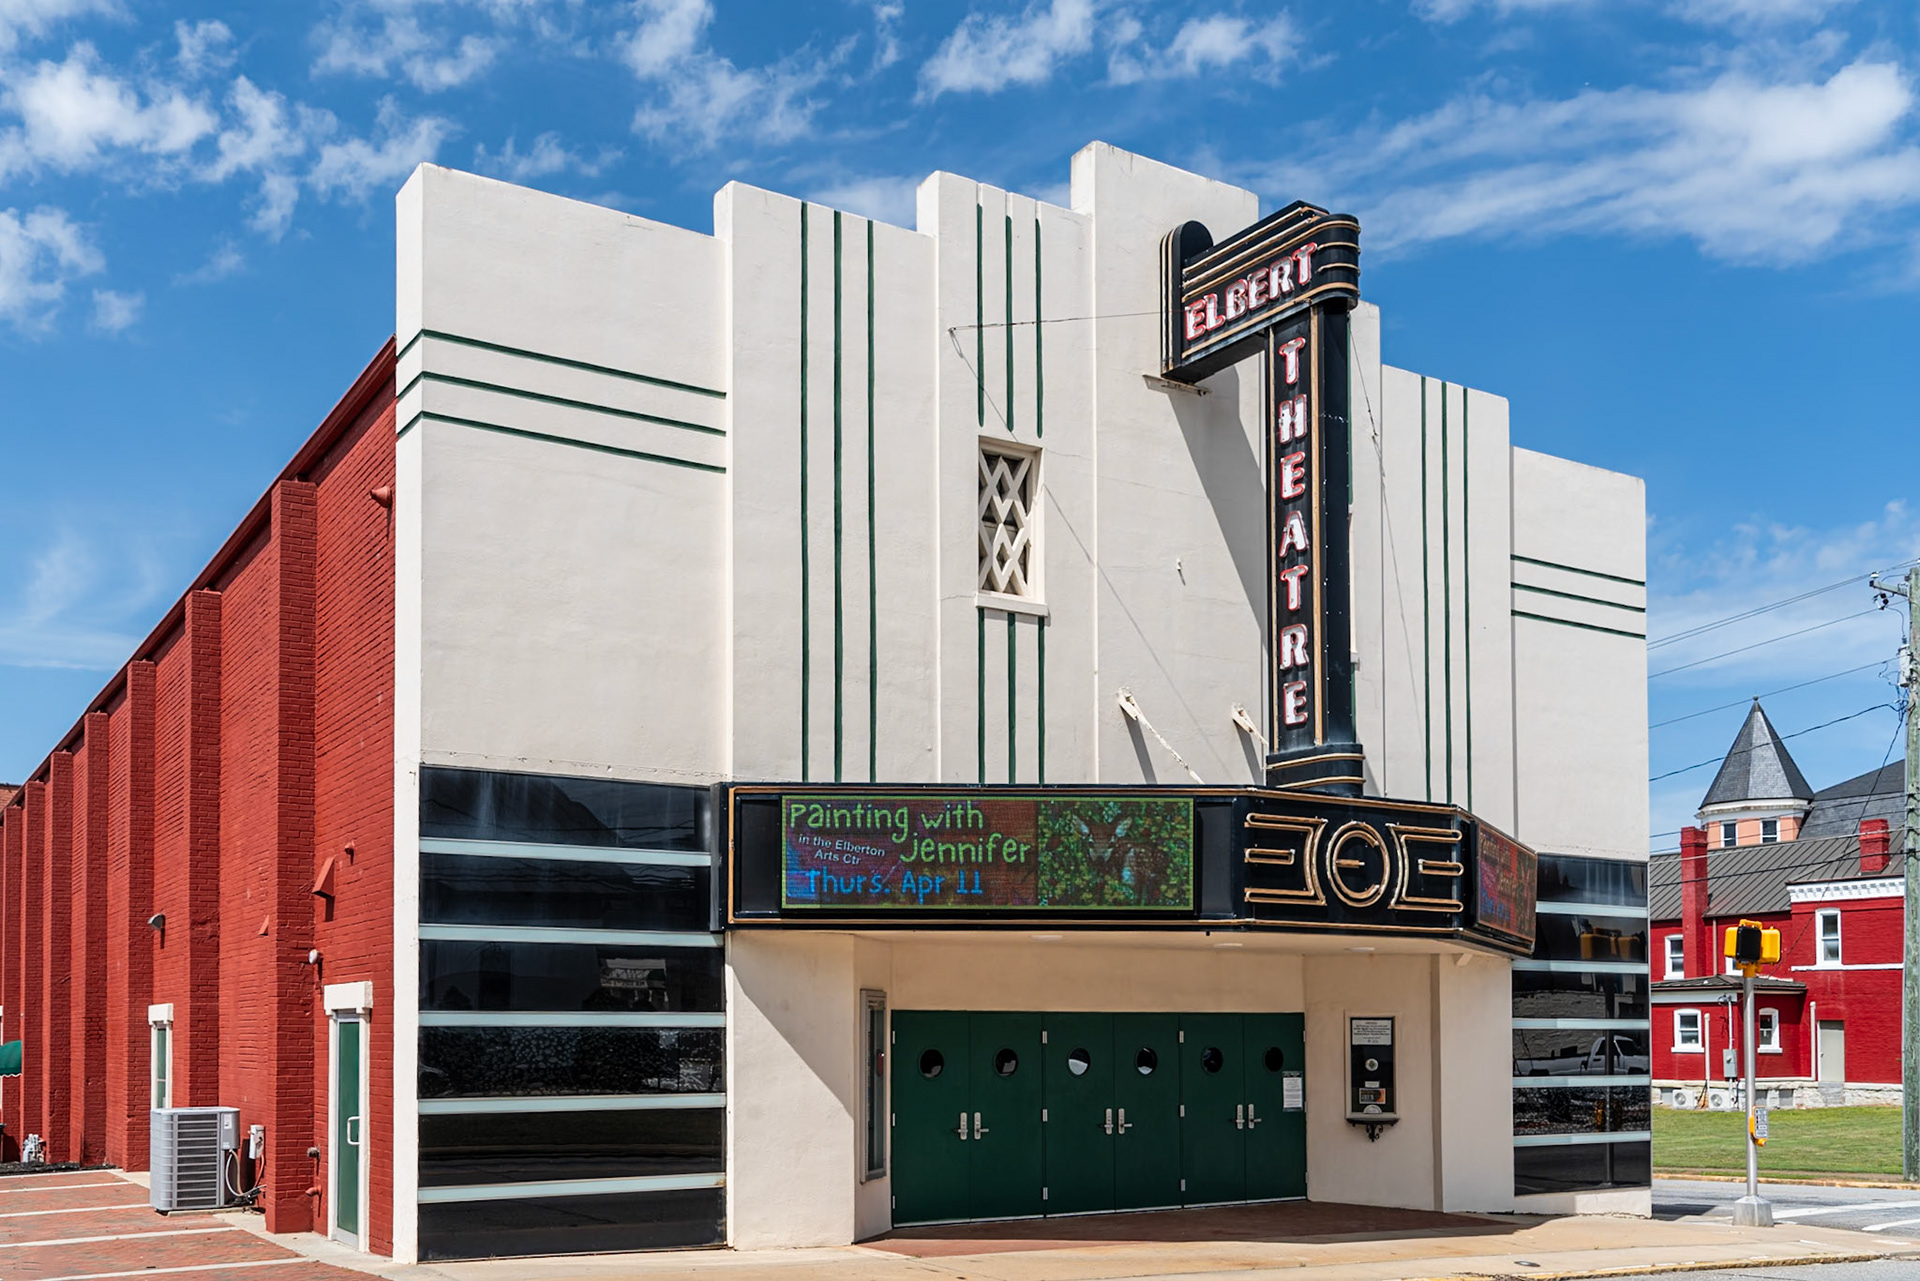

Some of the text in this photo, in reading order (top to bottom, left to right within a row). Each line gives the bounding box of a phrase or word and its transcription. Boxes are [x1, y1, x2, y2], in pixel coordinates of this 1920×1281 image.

[1184, 241, 1318, 341] ELBERT
[1278, 336, 1310, 726] THEATRE
[790, 800, 983, 843] Painting with
[798, 833, 886, 857] in the Elberton
[814, 849, 861, 865] Arts Ctr
[804, 866, 891, 894] Thurs.
[901, 870, 945, 905] Apr
